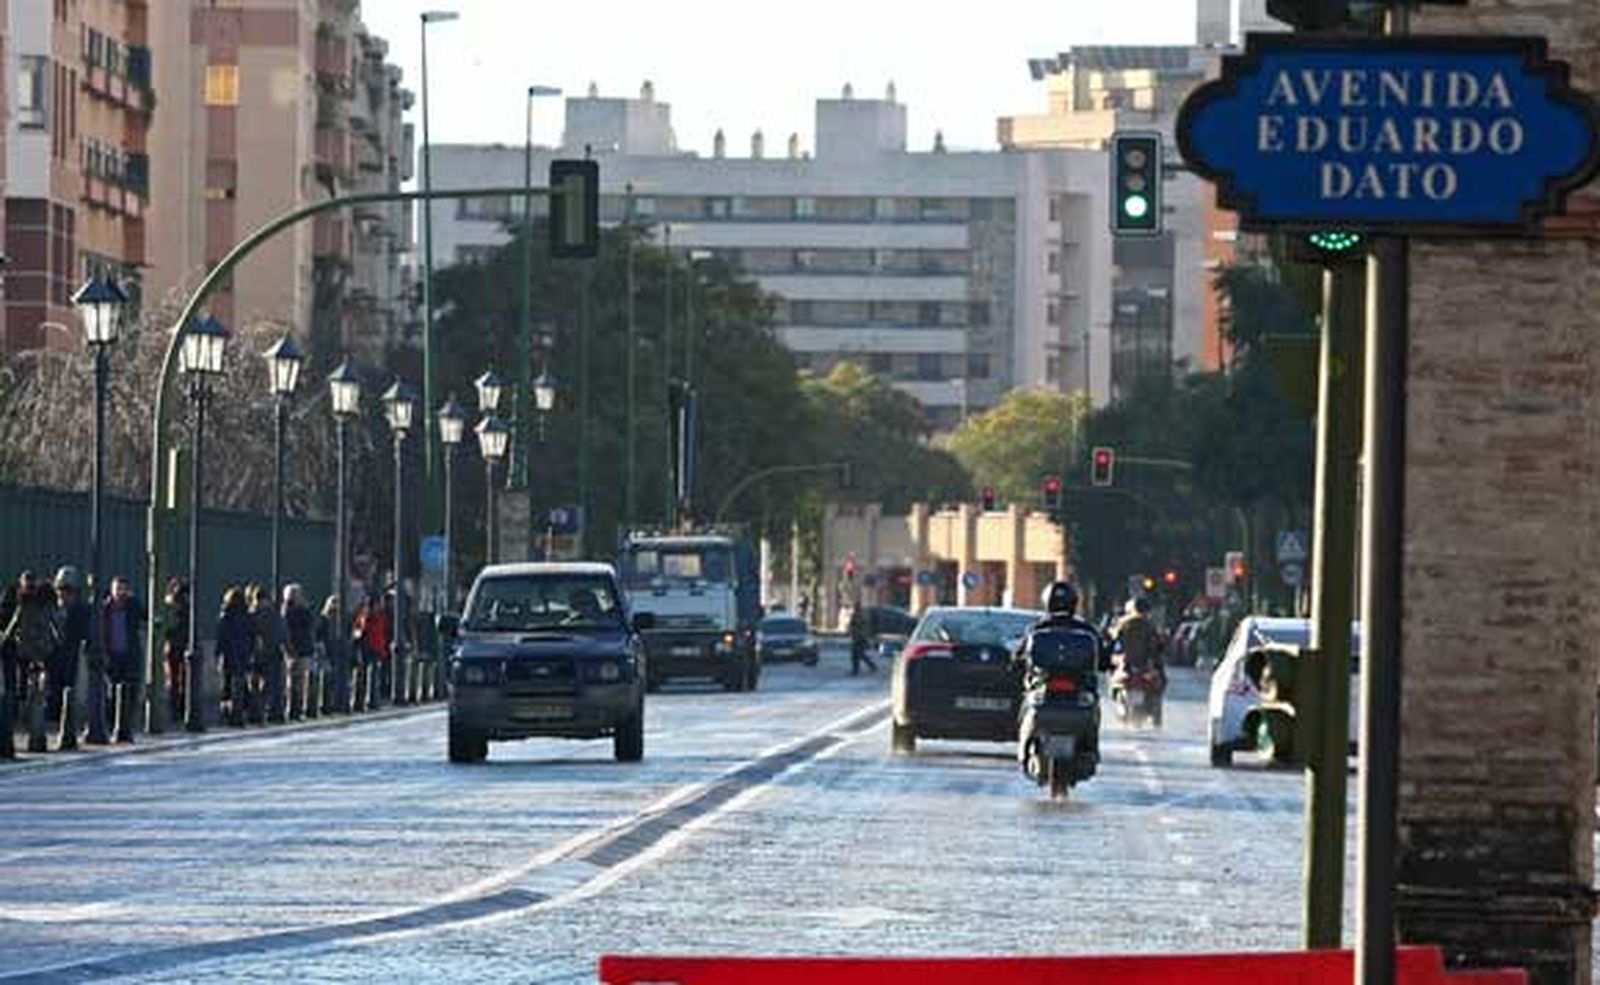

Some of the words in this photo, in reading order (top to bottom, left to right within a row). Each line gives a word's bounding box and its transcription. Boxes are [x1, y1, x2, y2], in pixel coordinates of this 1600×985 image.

[1266, 70, 1514, 108] AVENIDA
[1257, 115, 1525, 154] EDUARDO
[1321, 163, 1458, 200] DATO
